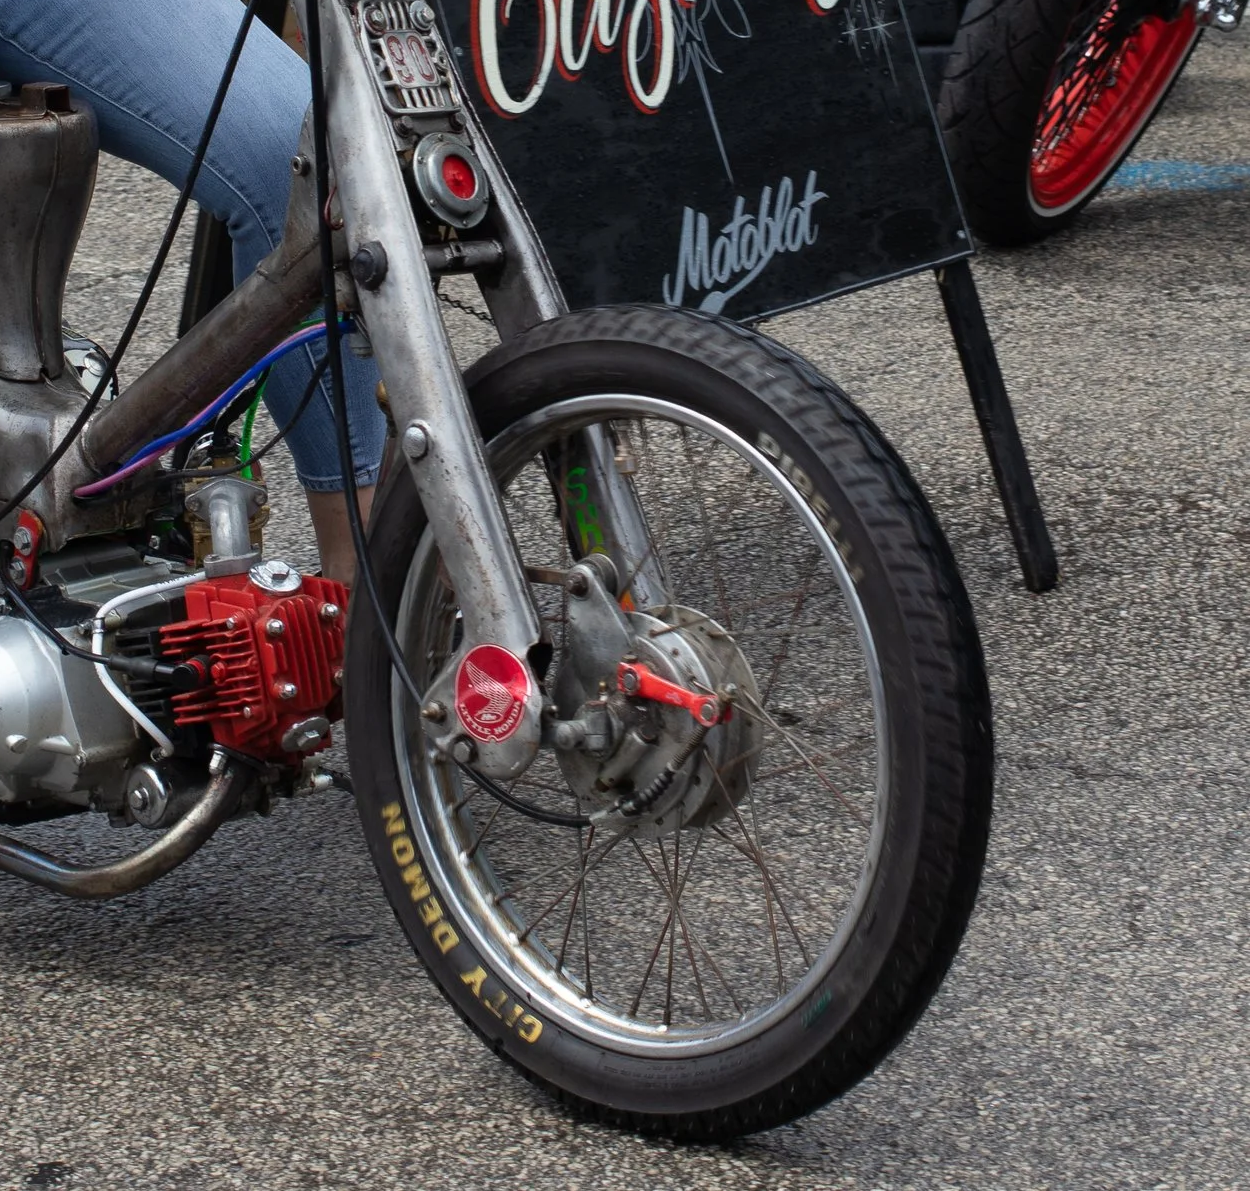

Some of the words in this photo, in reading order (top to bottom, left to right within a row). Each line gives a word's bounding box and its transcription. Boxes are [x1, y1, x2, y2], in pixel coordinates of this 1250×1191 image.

[386, 35, 436, 83] 90
[662, 169, 831, 311] Motoblot
[459, 703, 491, 735] LITTLE
[493, 700, 522, 735] HONDA
[381, 801, 460, 956] DEMON
[459, 964, 543, 1045] CITY
